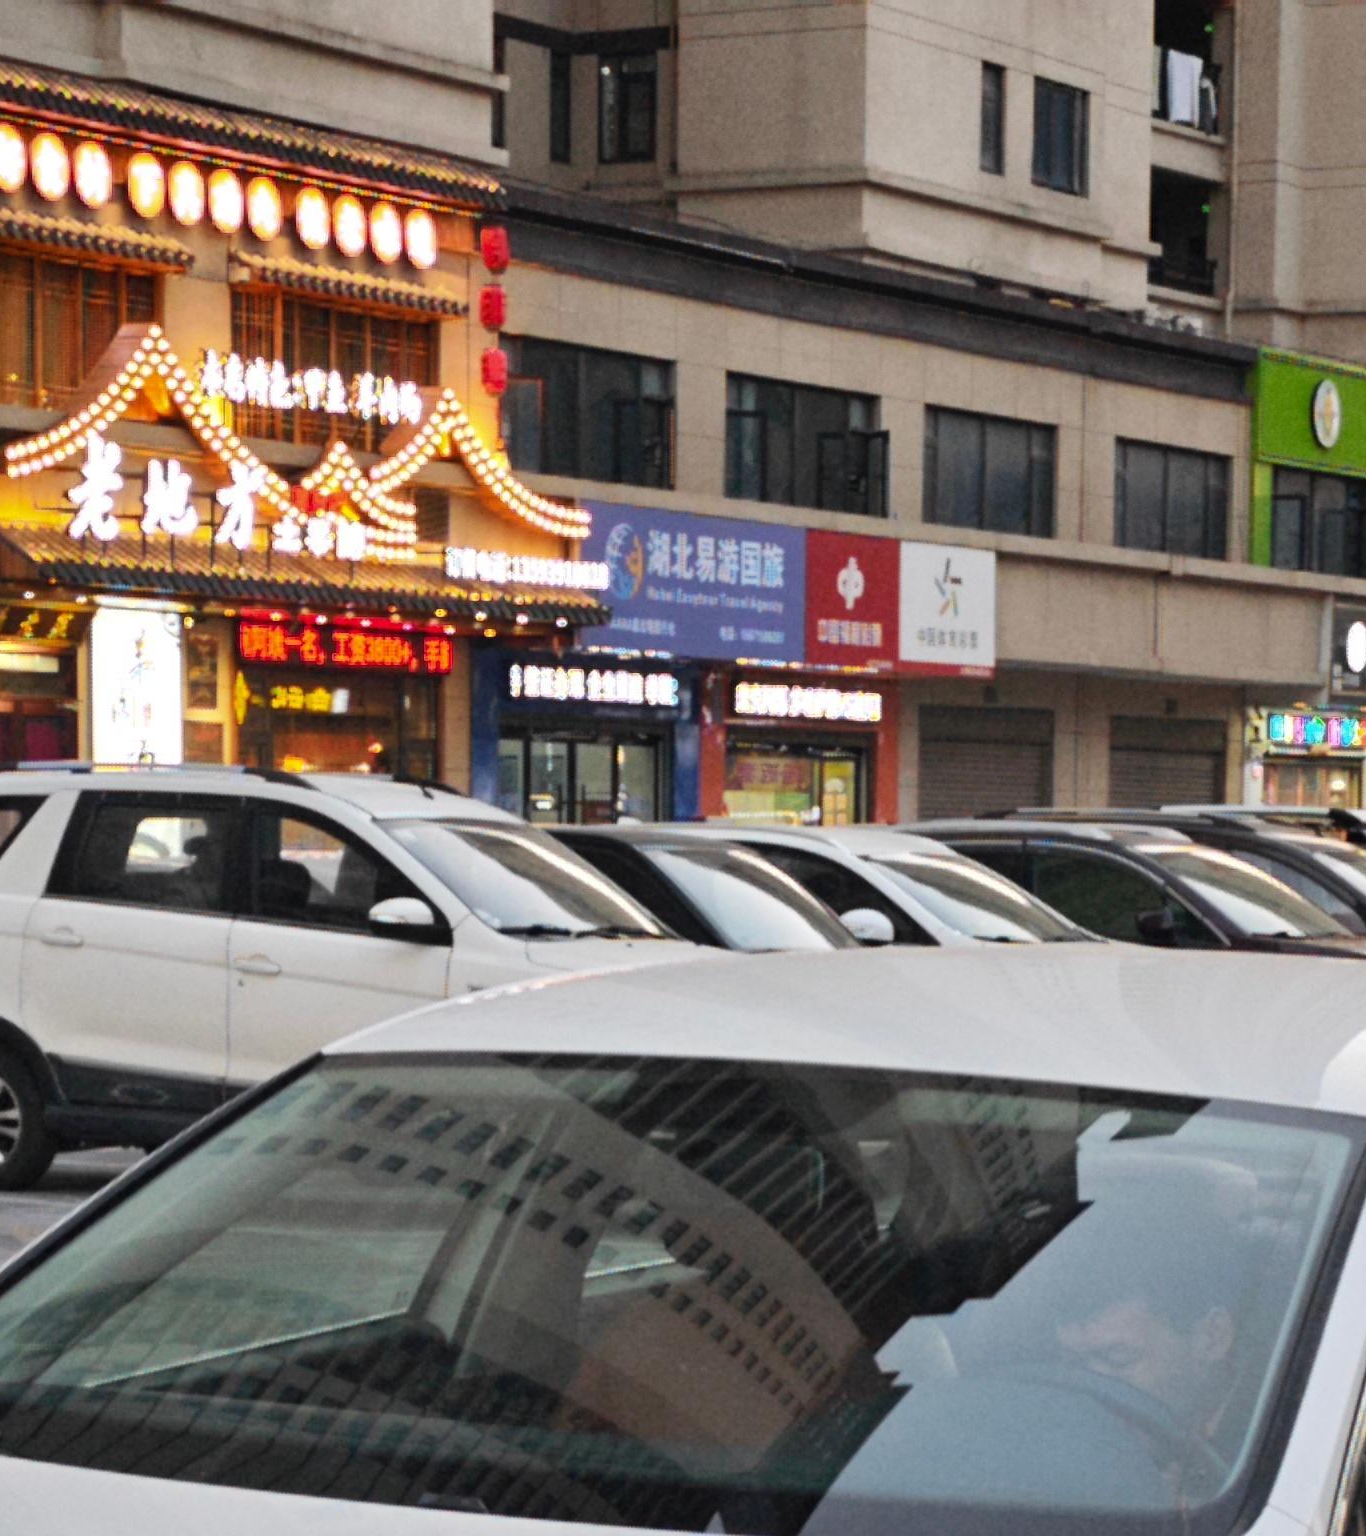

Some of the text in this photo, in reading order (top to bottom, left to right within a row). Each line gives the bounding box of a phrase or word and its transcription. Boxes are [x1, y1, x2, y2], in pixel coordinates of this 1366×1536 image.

[68, 429, 268, 550] 老地方
[646, 528, 786, 588] 湖北易游国旅
